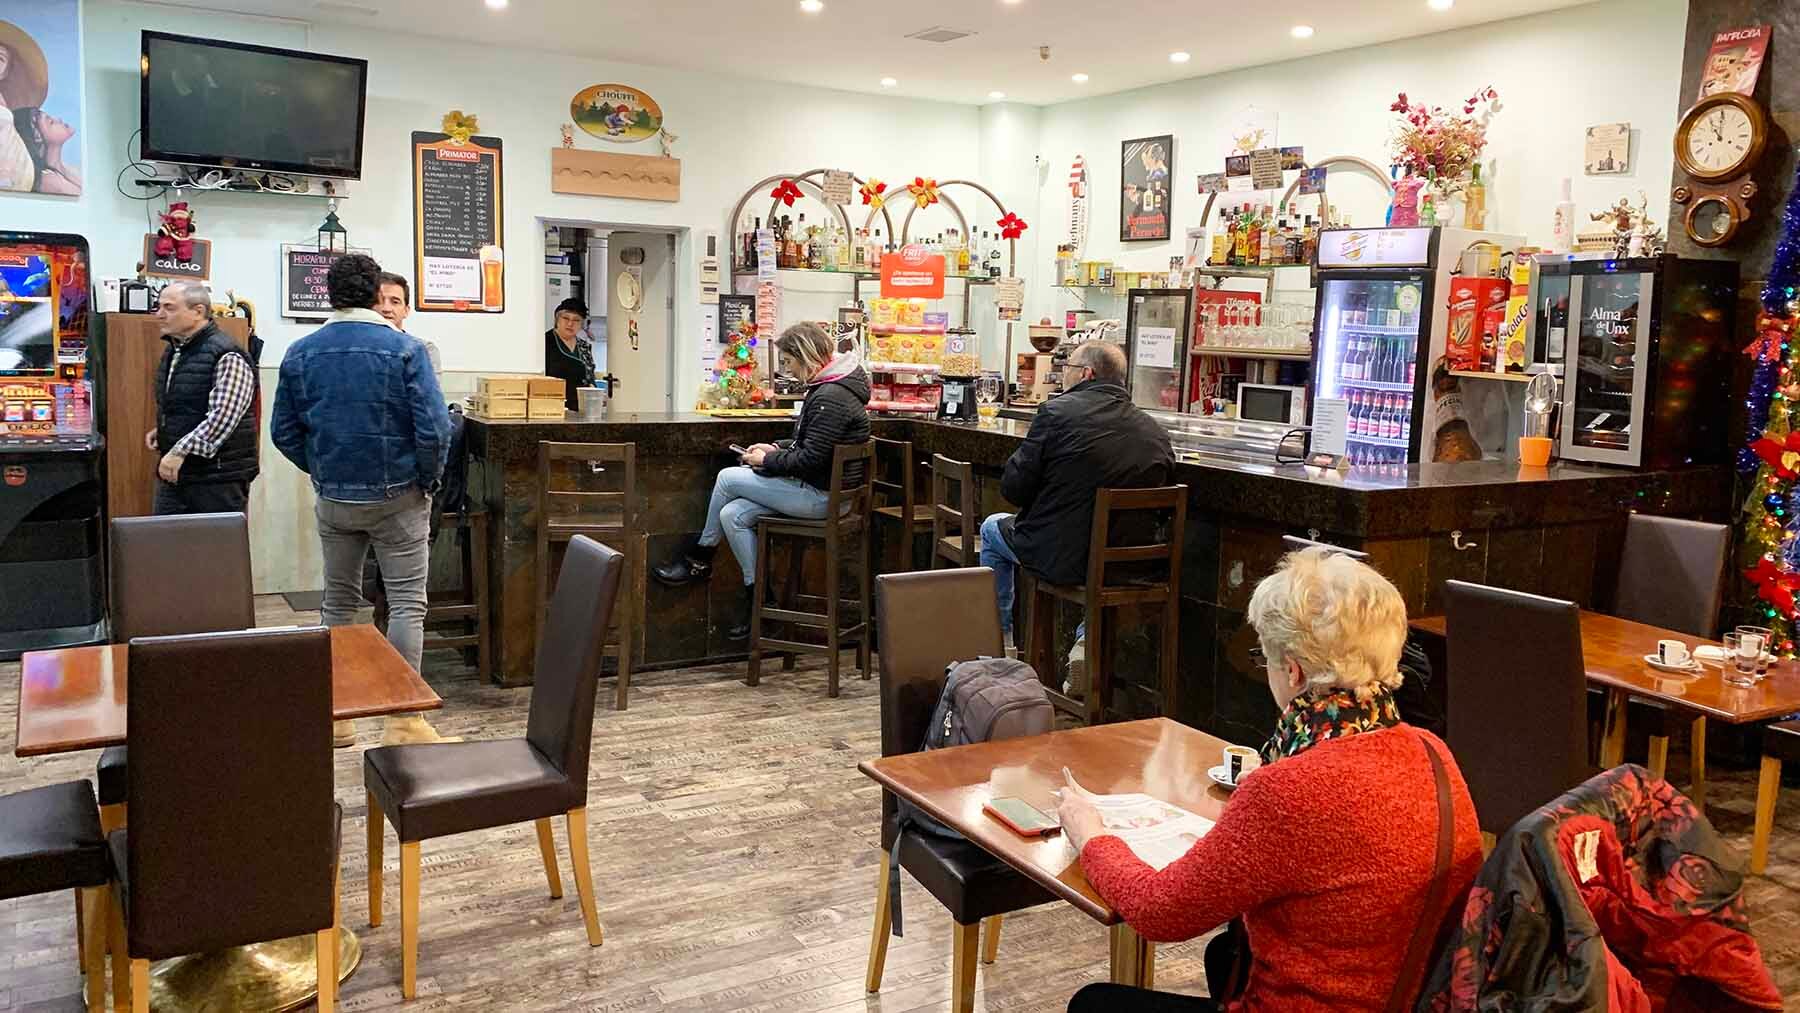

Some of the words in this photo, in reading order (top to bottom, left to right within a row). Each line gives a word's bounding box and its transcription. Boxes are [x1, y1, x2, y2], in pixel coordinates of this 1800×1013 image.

[440, 149, 477, 160] PRIMATOR
[1590, 307, 1621, 321] Alma
[1606, 321, 1630, 335] Unx
